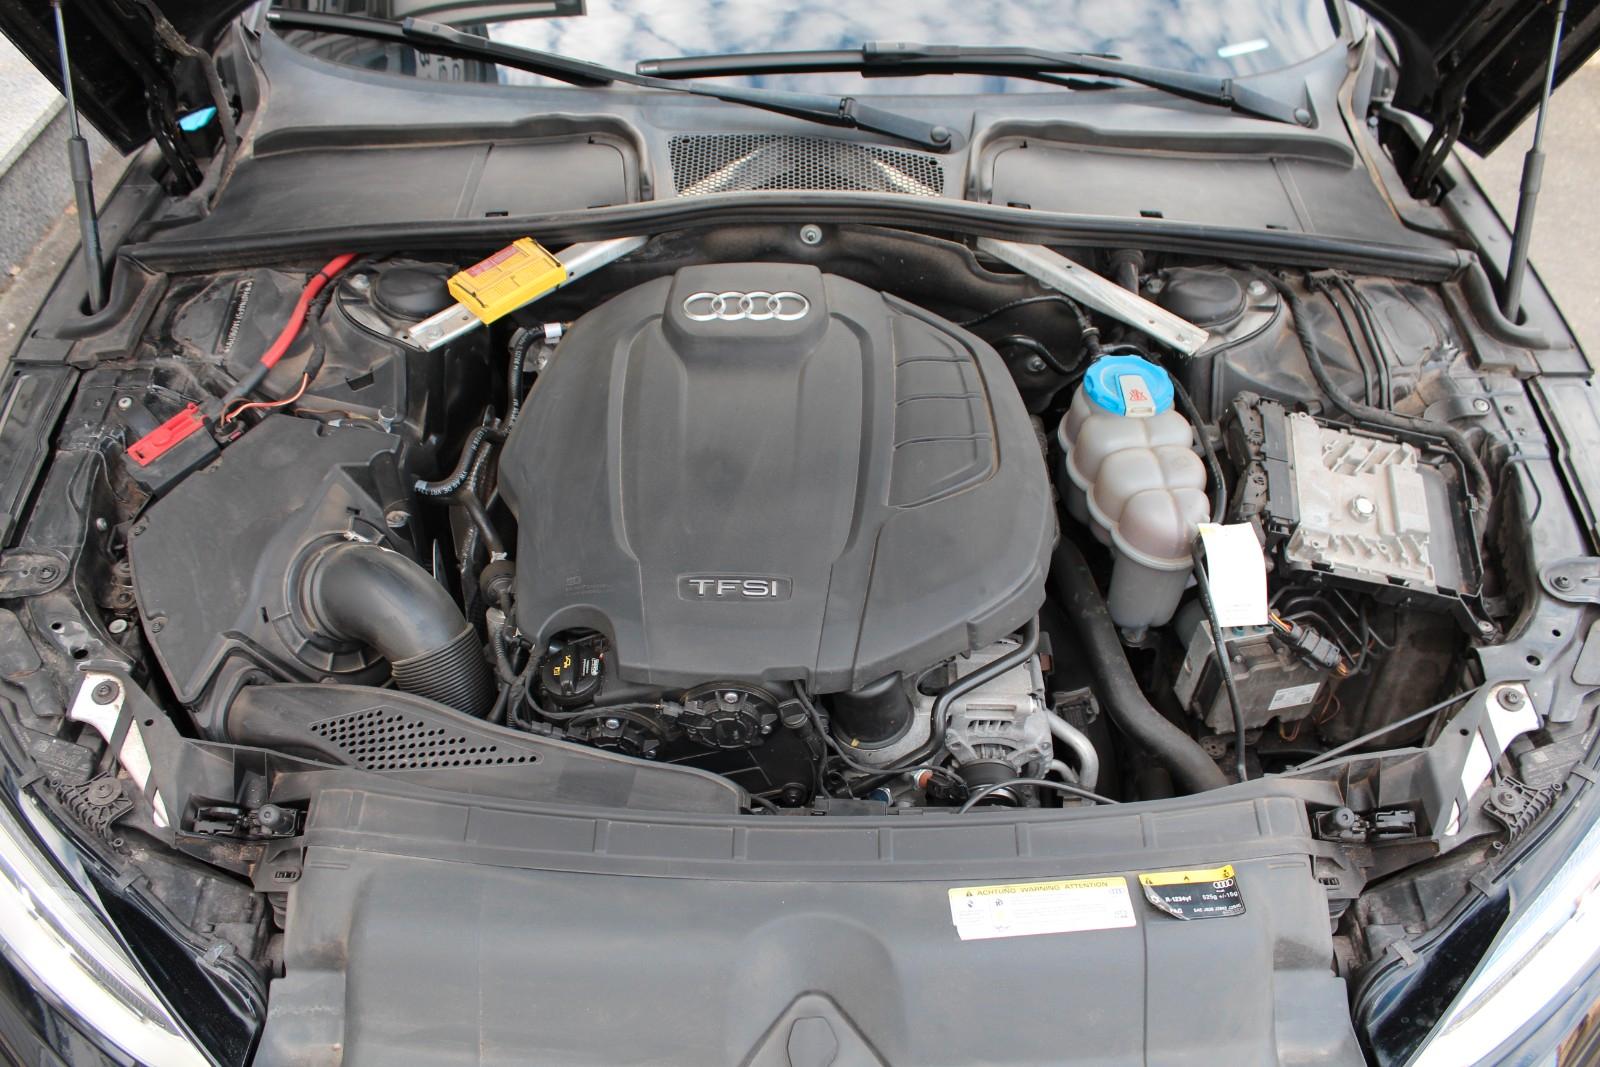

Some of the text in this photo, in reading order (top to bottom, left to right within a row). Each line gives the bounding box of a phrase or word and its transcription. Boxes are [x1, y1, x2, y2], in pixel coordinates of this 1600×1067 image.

[688, 579, 778, 598] TFSI
[976, 881, 1109, 896] ACHTUNG WARNING ATTENTION
